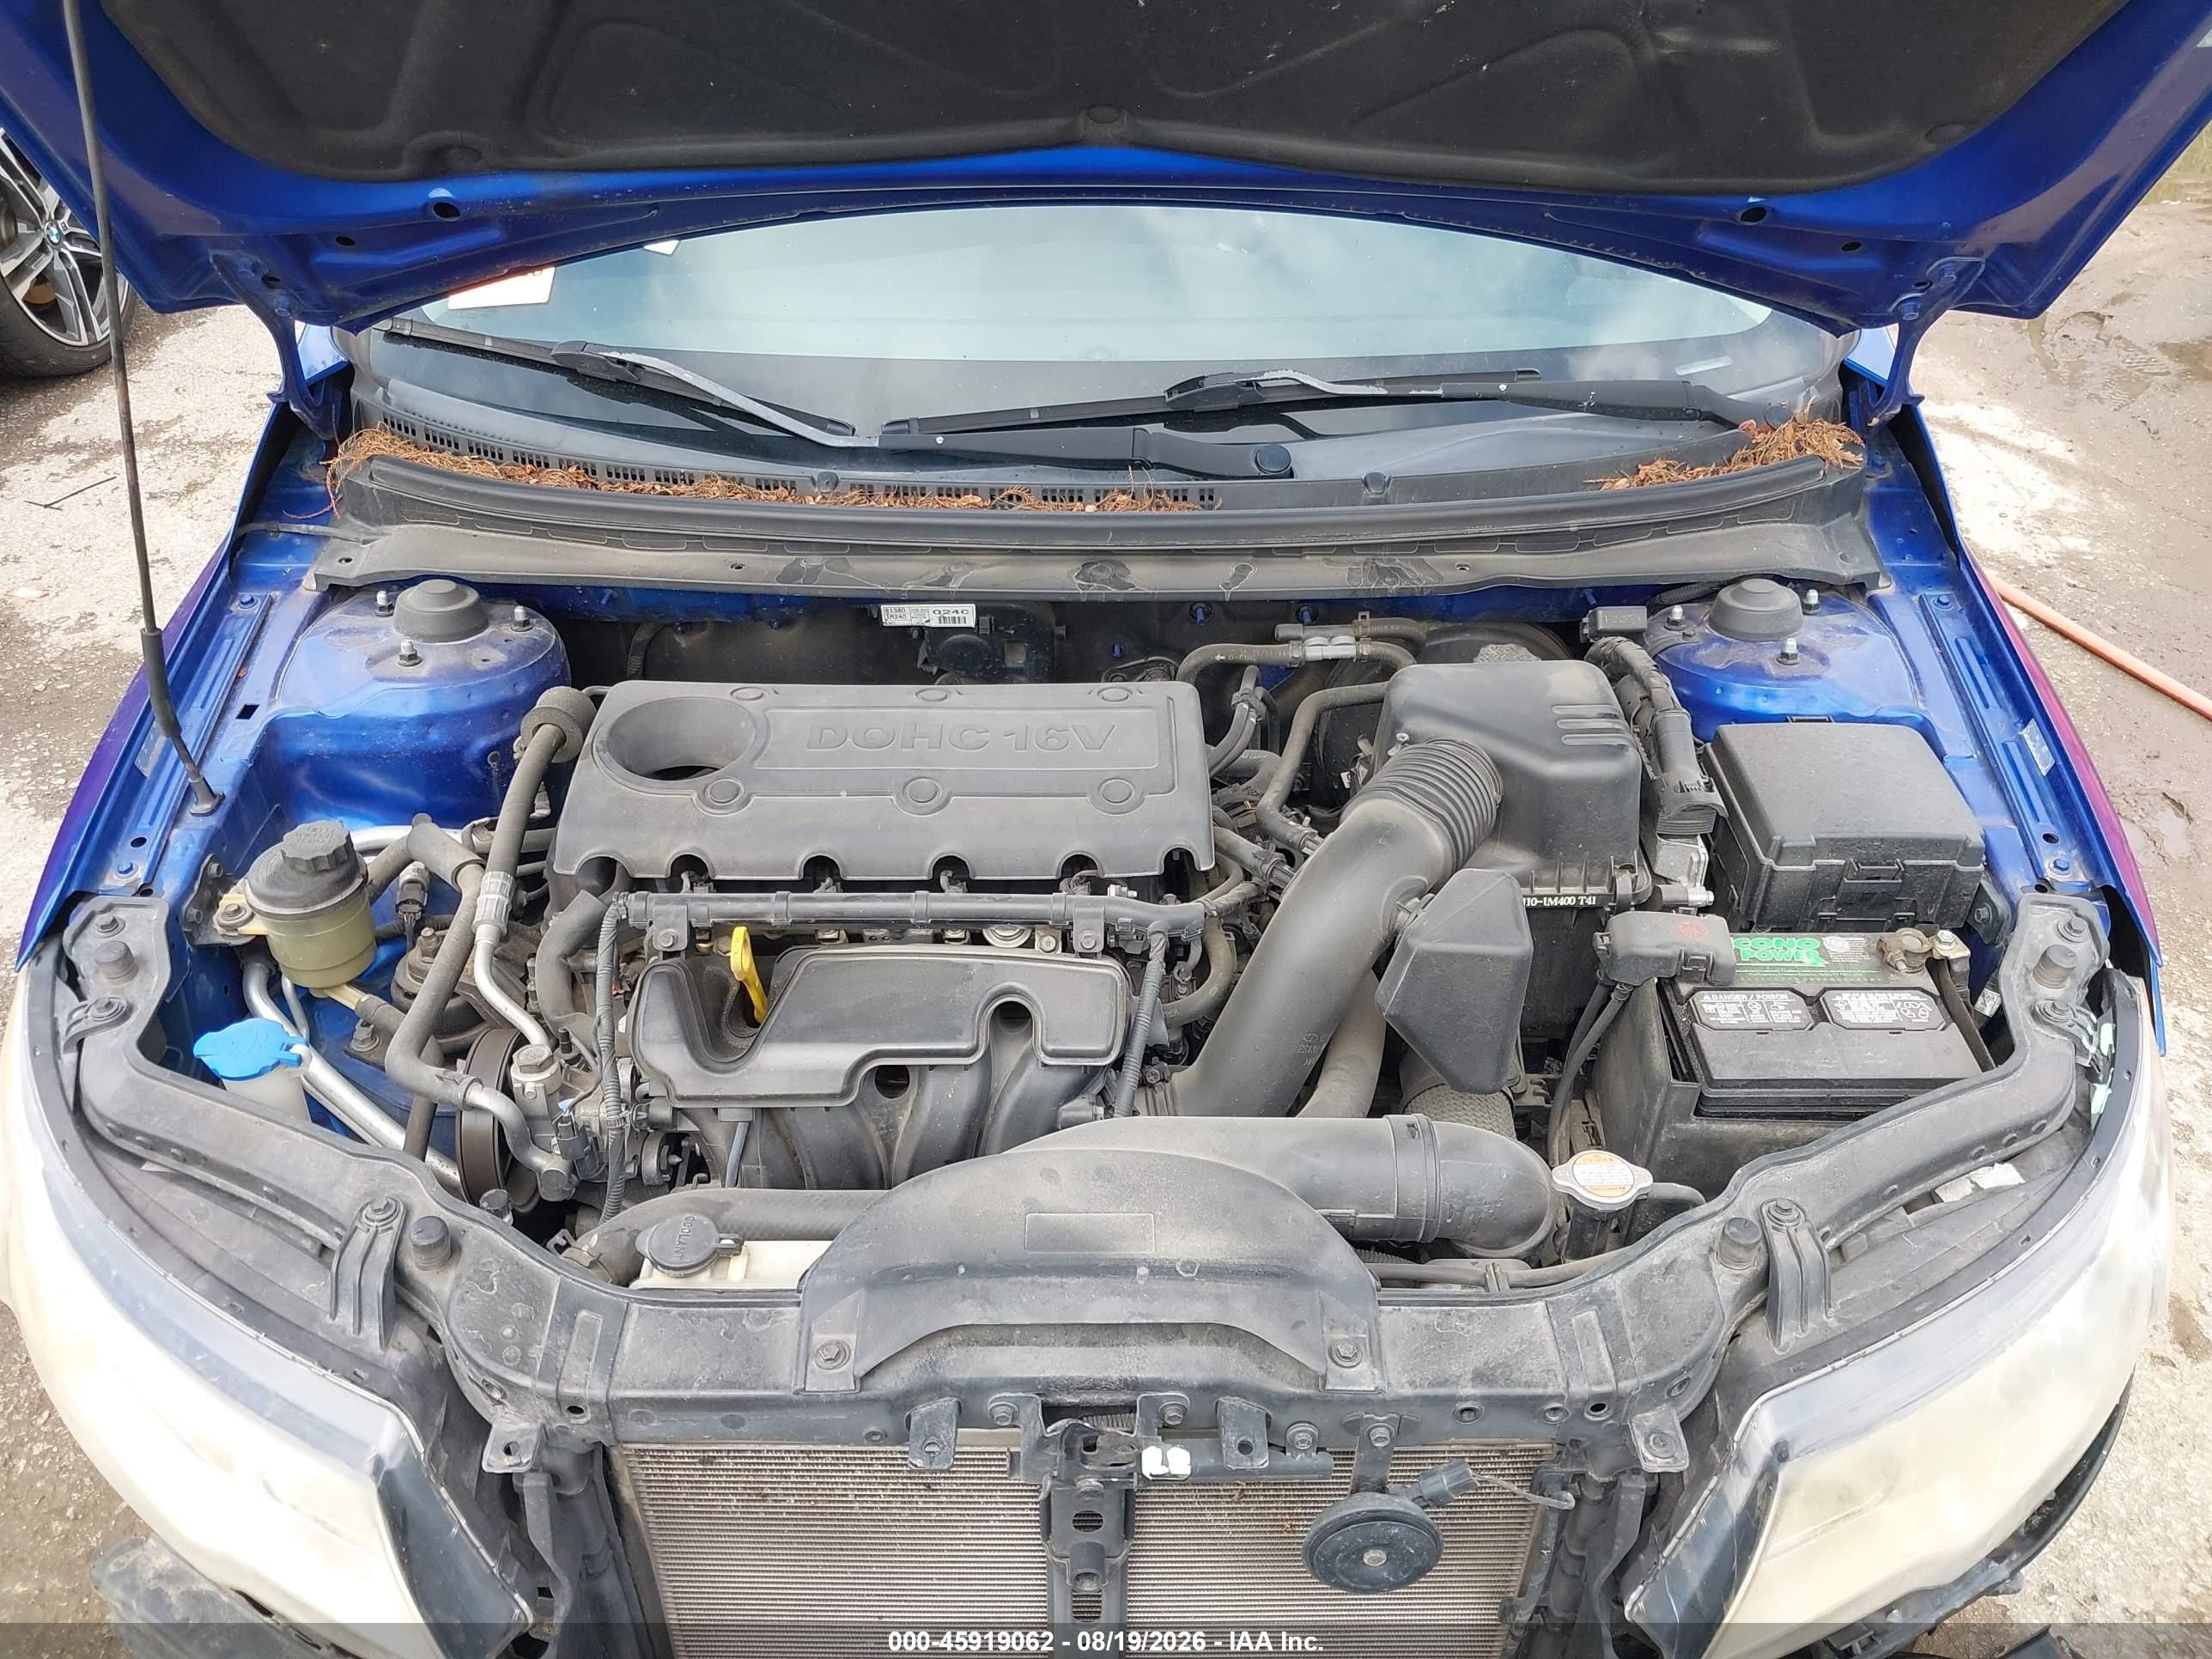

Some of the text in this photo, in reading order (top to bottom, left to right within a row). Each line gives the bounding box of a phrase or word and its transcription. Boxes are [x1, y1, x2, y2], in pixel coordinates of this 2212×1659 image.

[805, 723, 1116, 751] DOHC 16V
[1577, 896, 1596, 905] T41
[1731, 937, 1820, 950] CONO
[1740, 949, 1823, 963] POWER
[673, 1215, 696, 1260] COOLANT
